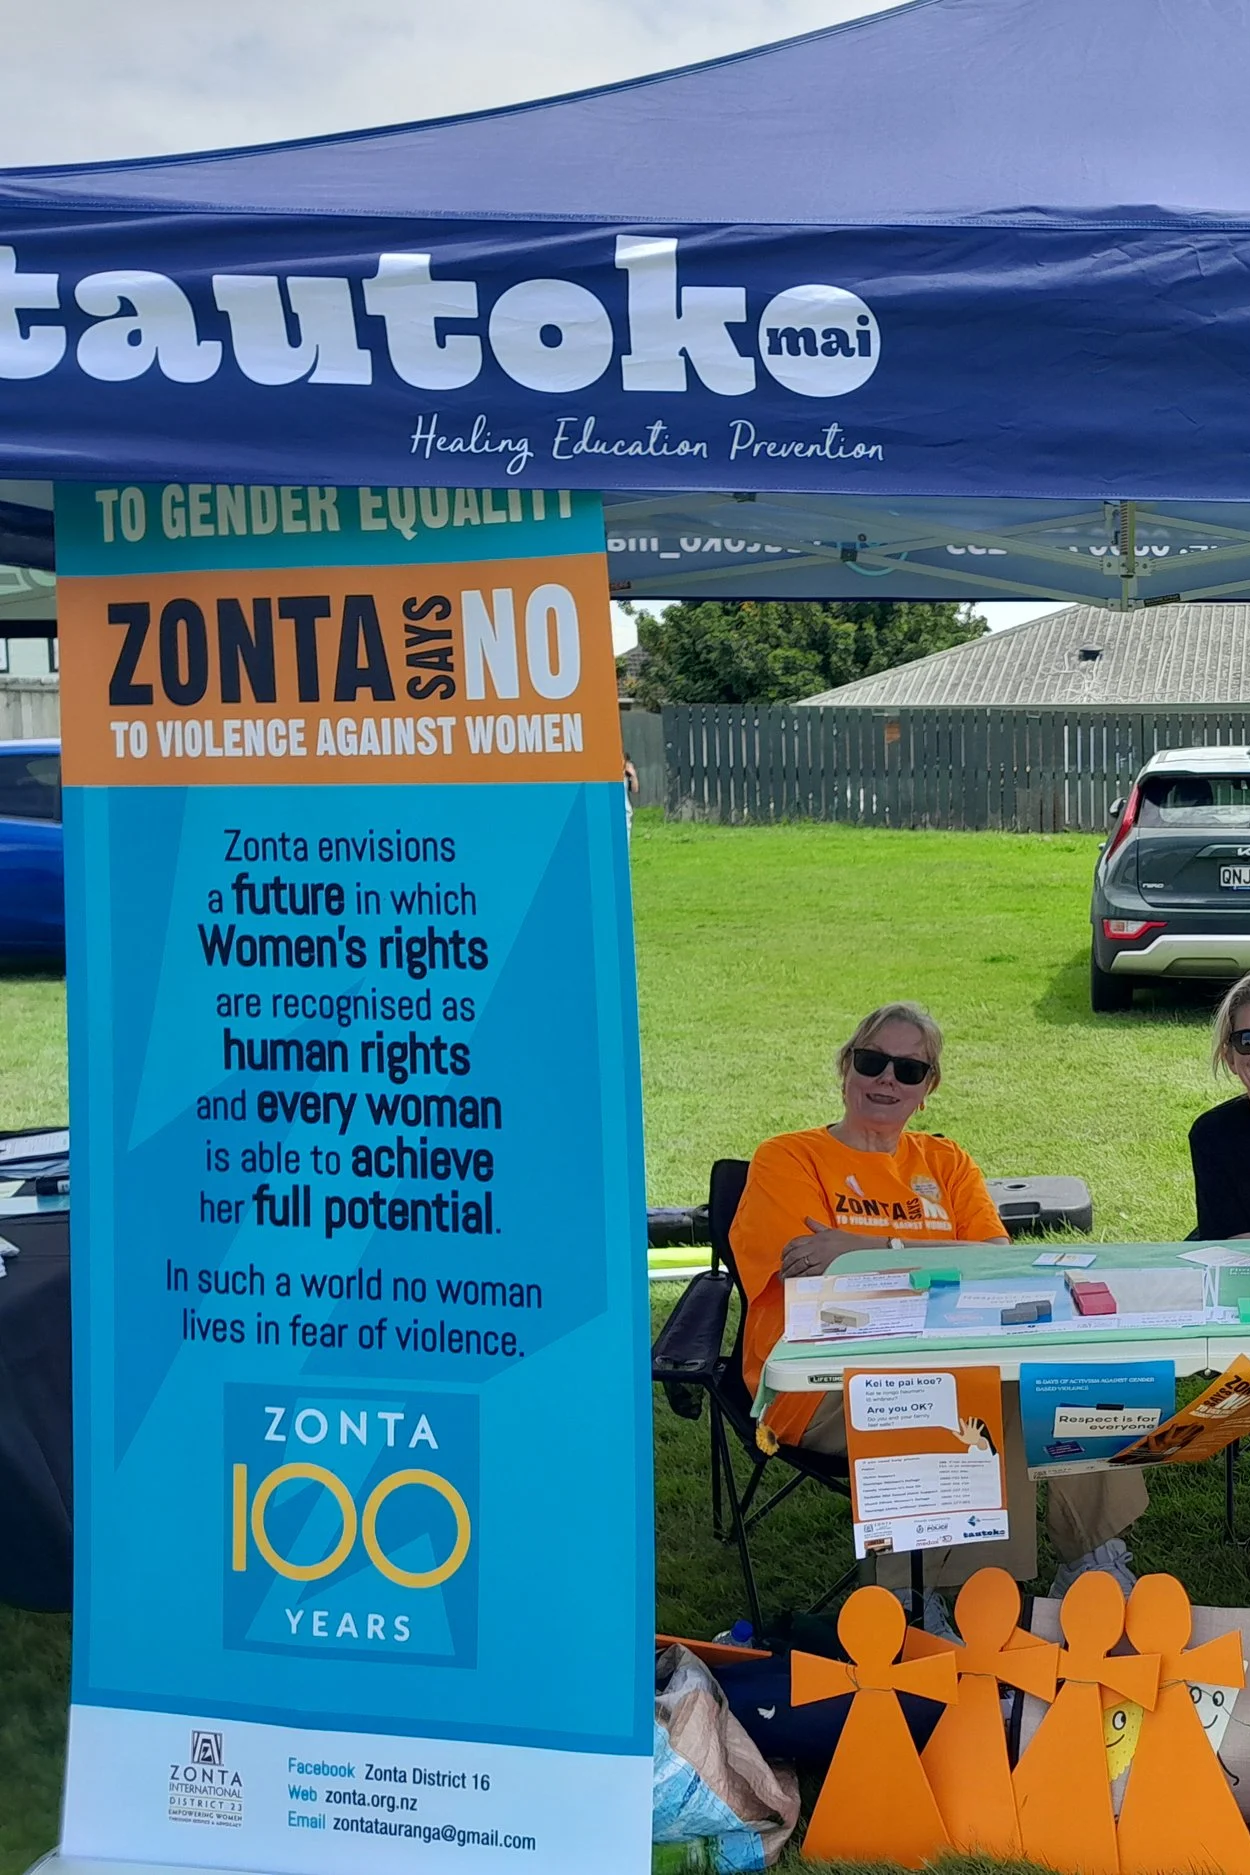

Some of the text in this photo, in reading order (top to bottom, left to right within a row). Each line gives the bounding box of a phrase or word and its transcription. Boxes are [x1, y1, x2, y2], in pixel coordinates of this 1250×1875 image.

[767, 315, 872, 359] mai
[410, 413, 885, 476] Healing Education Prevention
[96, 486, 147, 543] TO
[160, 486, 341, 539] GENDER
[107, 582, 582, 707] ZONTA SAYS NO
[110, 712, 584, 759] TO VIOLENCE AGAINST WOMEN
[222, 828, 456, 864] Zonta envisions
[207, 872, 477, 916] a future in which
[197, 923, 489, 980] Women's rights
[215, 987, 476, 1028] are recognised as
[222, 1027, 472, 1085] human rights
[196, 1089, 502, 1136] and every woman
[205, 1135, 494, 1182] is able to achieve
[199, 1184, 502, 1240] her full potential.
[834, 1191, 908, 1221] ZONTA
[906, 1197, 923, 1220] SAYS
[166, 1258, 543, 1310] In such a world no woman
[181, 1307, 525, 1358] lives in fear of violence.
[811, 1374, 844, 1384] LIFETIM
[865, 1379, 882, 1388] Kei
[898, 1378, 914, 1388] pai
[916, 1377, 943, 1386] koe?
[262, 1405, 440, 1451] ZONTA
[867, 1402, 934, 1415] Are you OK?
[1058, 1415, 1119, 1424] Respect
[1137, 1415, 1157, 1423] for
[1089, 1423, 1156, 1431] everyone
[231, 1462, 472, 1590] 100
[283, 1608, 412, 1642] YEARS
[168, 1782, 244, 1799] INTERNATIONAL
[170, 1765, 243, 1787] ZONTA
[287, 1757, 491, 1791] Facebook Zonta District 16
[169, 1796, 242, 1812] DISTRICT 23
[287, 1784, 419, 1813] Web zonta.org.nz
[287, 1810, 537, 1851] Email zontatauranga@gmail.com
